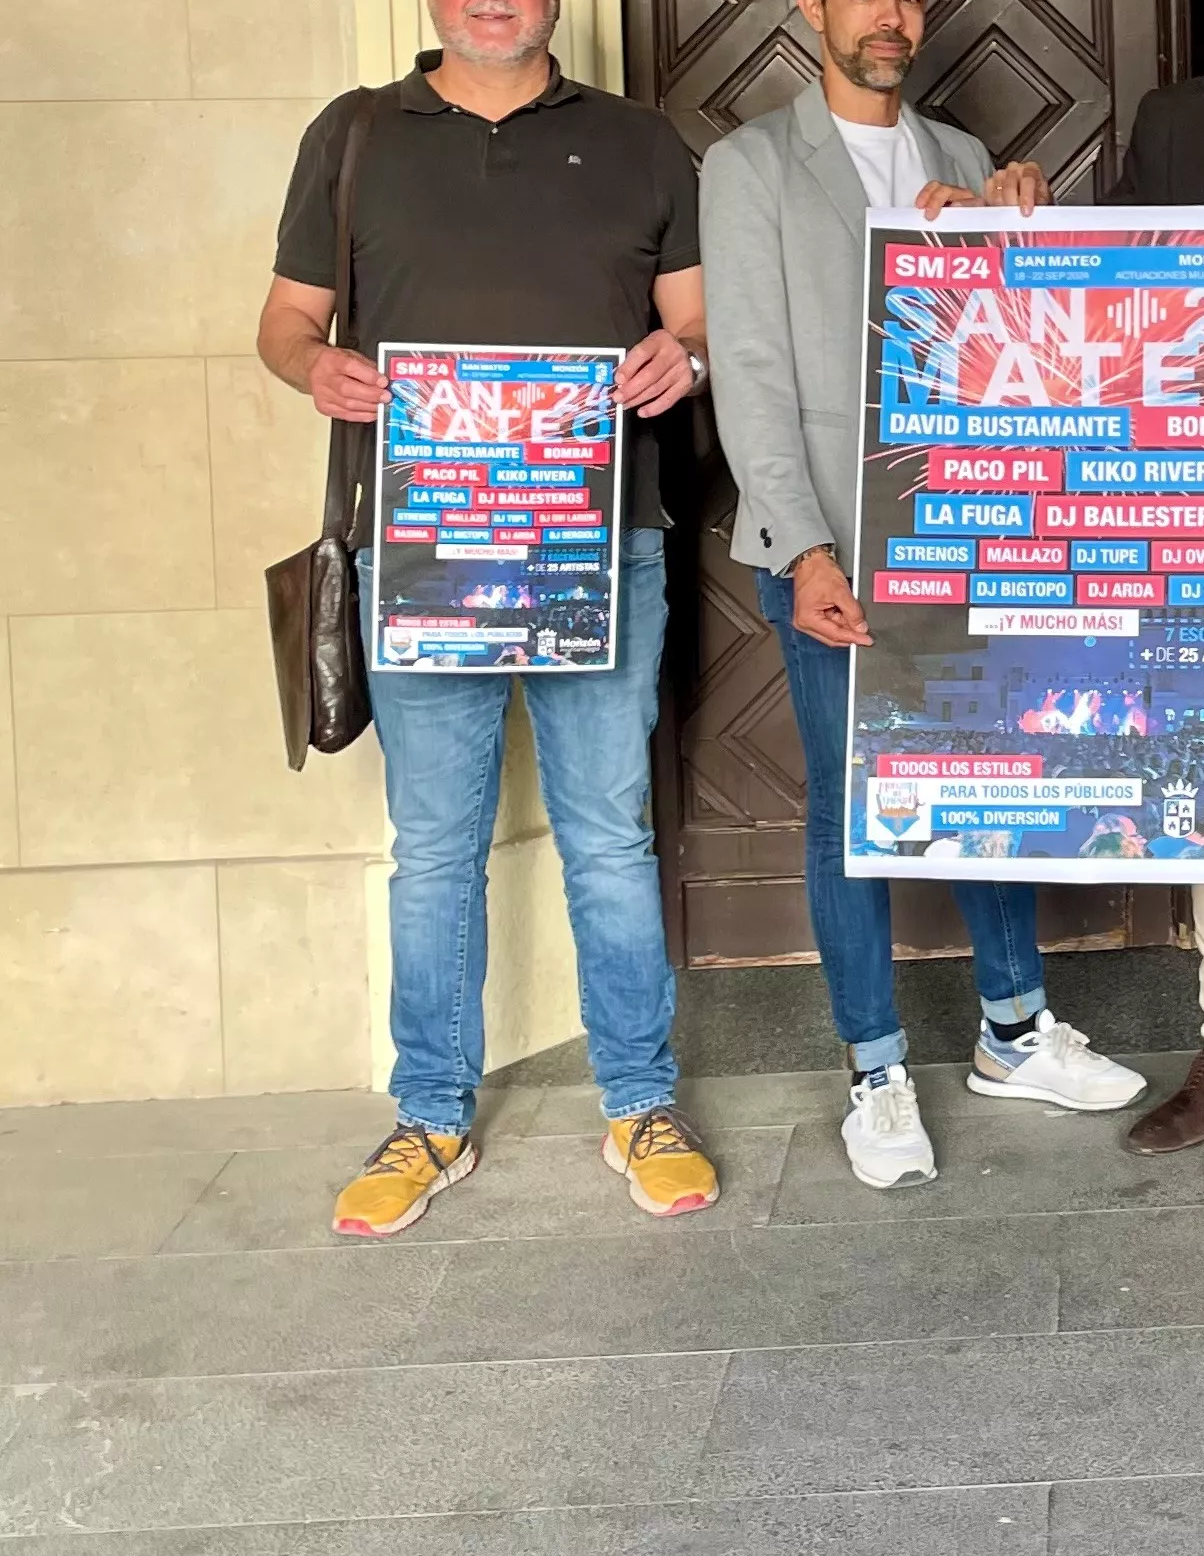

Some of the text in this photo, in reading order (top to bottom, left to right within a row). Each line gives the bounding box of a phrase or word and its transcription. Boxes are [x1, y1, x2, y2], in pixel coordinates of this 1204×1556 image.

[895, 253, 991, 280] SM 24
[1014, 255, 1101, 268] SAN MATEO
[883, 287, 1086, 345] SAN
[395, 361, 449, 376] SM 24
[389, 379, 612, 412] SAN 24
[889, 412, 1122, 438] DAVID BUSTAMANTE
[394, 445, 520, 459] DAVID BUSTAMANTE
[423, 469, 480, 481] PACO PIL
[496, 470, 576, 482] KIKO RIVERA
[943, 459, 1049, 482] PACO PIL
[1080, 460, 1137, 482] KIKO
[413, 491, 466, 504] LA FUGA
[477, 492, 495, 504] DJ
[924, 503, 1023, 526] LA FUGA
[1046, 505, 1076, 527] DJ
[894, 545, 969, 563] STRENOS
[986, 547, 1063, 564] MALLAZO
[1076, 548, 1139, 564] DJ TUPE
[1162, 548, 1182, 565] DJ
[887, 579, 953, 597] RASMIA
[976, 581, 1067, 598] DJ BIGTOPO
[1087, 582, 1155, 598] DJ ARDA
[1181, 583, 1201, 599] DJ
[1019, 615, 1078, 630] MUCHO
[1082, 614, 1124, 631] MÁS!
[1164, 627, 1174, 642] 7
[1155, 647, 1176, 662] DE
[1178, 647, 1199, 663] 25
[890, 761, 1032, 776] TODOS LOS ESTILOS
[940, 784, 978, 798] PARA
[981, 785, 1029, 799] TODOS
[1033, 785, 1060, 799] LOS
[940, 808, 1060, 825] 100% DIVERSIÓN
